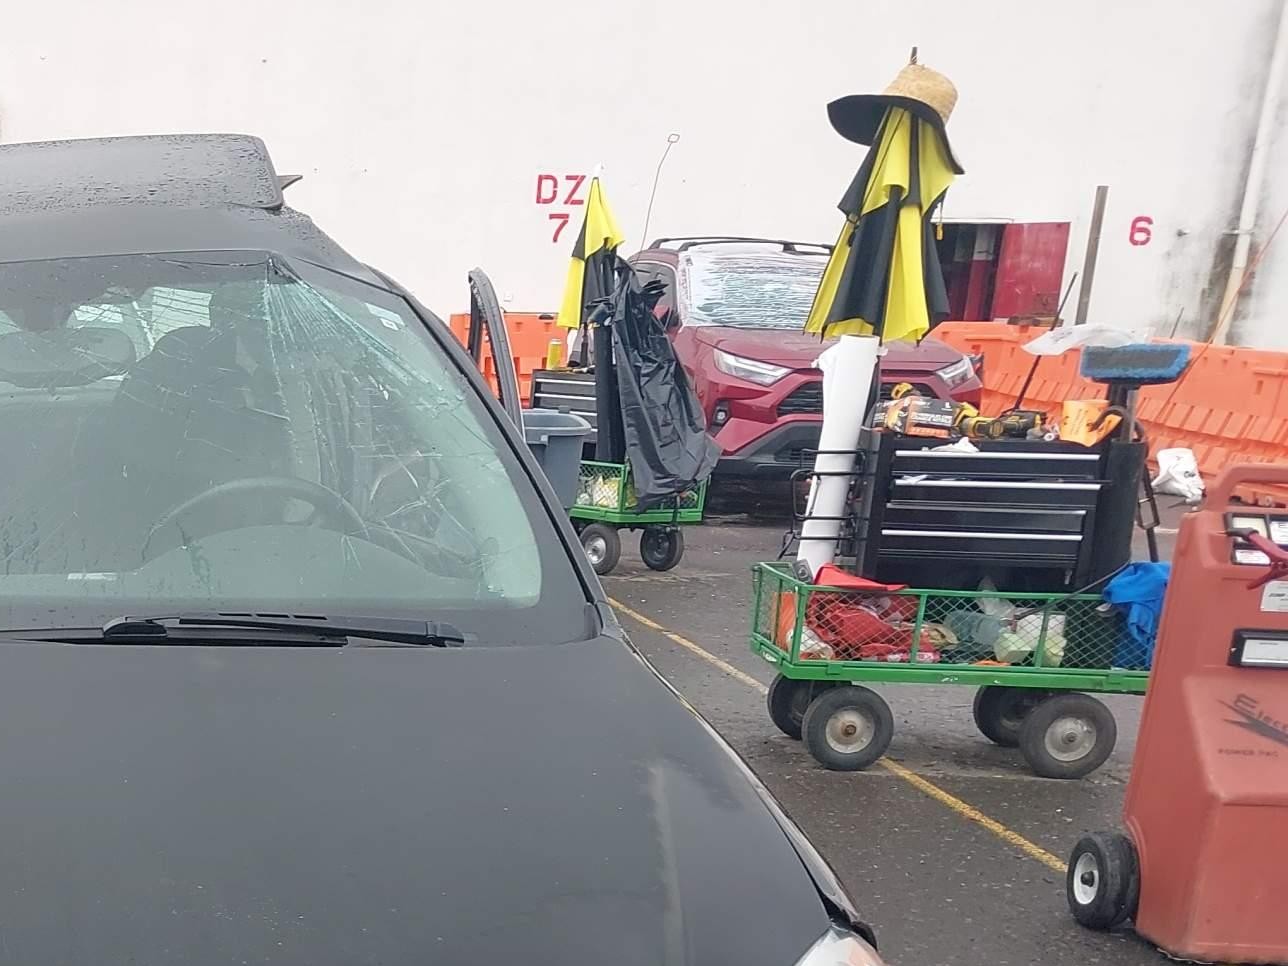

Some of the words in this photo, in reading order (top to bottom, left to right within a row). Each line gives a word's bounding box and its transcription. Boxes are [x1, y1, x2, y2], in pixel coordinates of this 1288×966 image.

[535, 174, 587, 205] DZ
[548, 213, 570, 243] 7
[1129, 215, 1154, 246] 6
